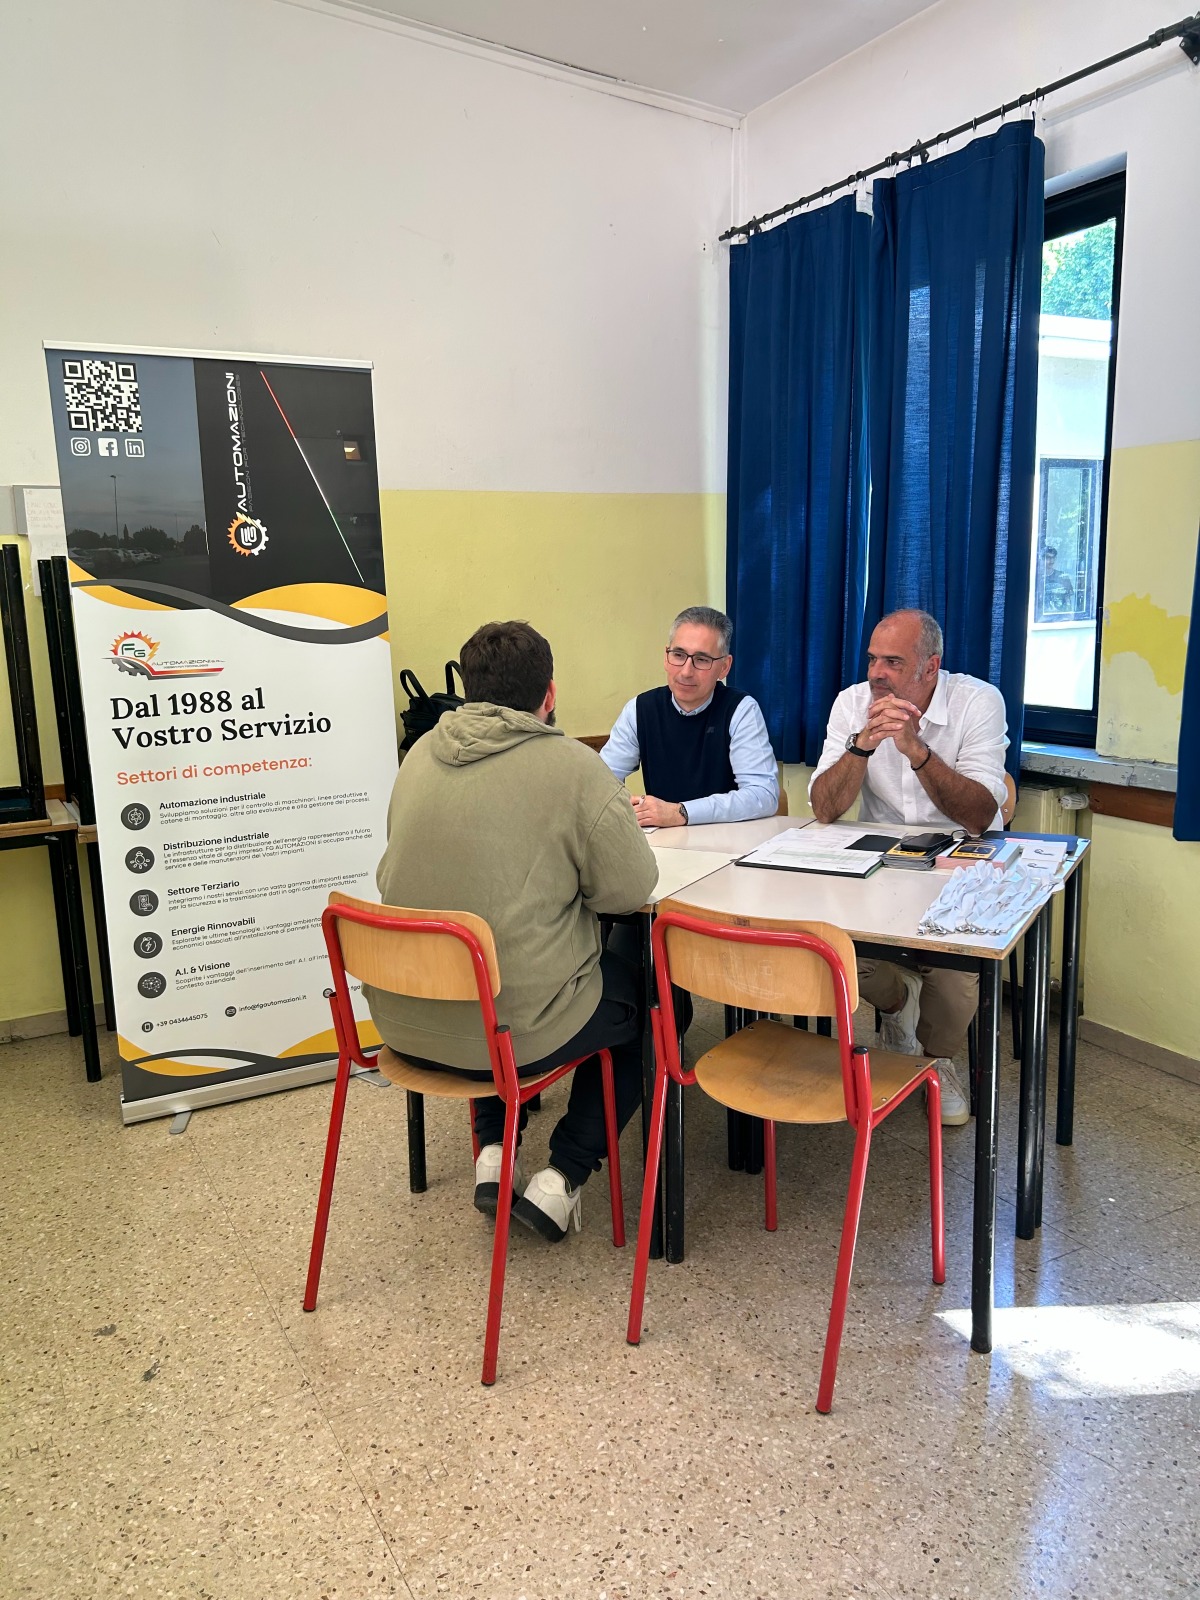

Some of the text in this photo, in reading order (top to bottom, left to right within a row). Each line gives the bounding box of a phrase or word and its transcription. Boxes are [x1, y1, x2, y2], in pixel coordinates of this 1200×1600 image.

[225, 372, 248, 512] AUTOMAZIONI
[122, 643, 146, 657] FG
[110, 687, 265, 719] Dal 1988 al
[112, 712, 331, 749] Vostro Servizio
[117, 756, 312, 785] Settori di competenza:
[160, 792, 266, 809] Automazione industriale
[164, 832, 269, 850] Distribuzione industriale
[168, 880, 240, 896] Settore Terziario
[172, 916, 255, 936] Energie Rinnovabili
[294, 916, 321, 925] ambienta
[309, 953, 329, 961] all'inte
[175, 968, 188, 976] A.I.
[198, 962, 230, 972] Visione
